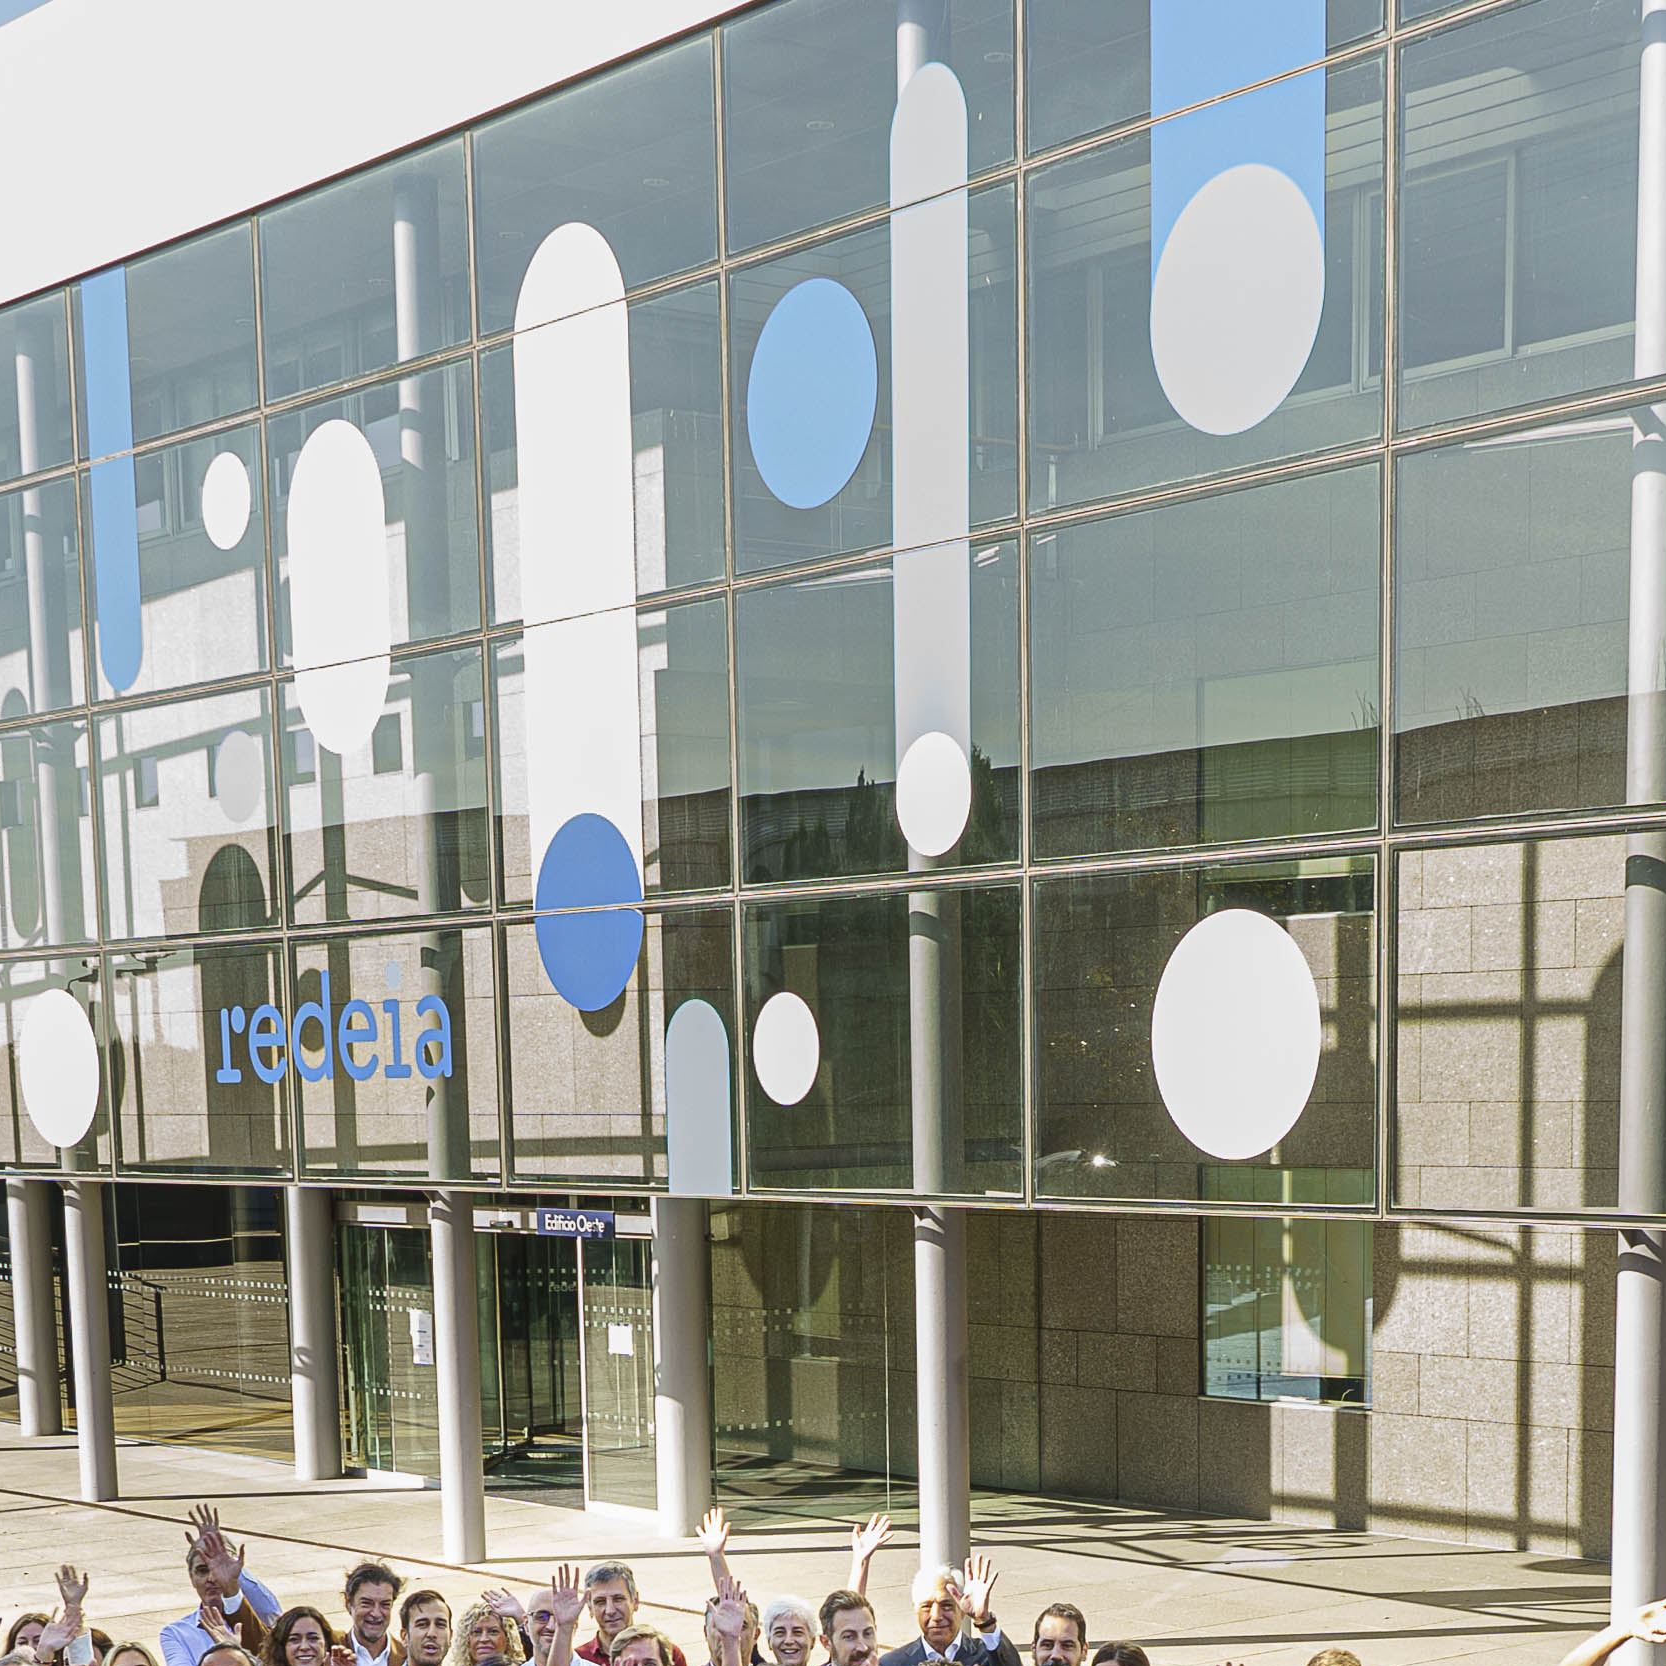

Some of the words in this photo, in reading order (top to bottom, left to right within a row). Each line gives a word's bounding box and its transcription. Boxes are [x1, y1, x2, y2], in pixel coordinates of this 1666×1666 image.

[216, 961, 453, 1084] redeia
[544, 1213, 576, 1231] Edificio
[576, 1214, 605, 1233] Oeste
